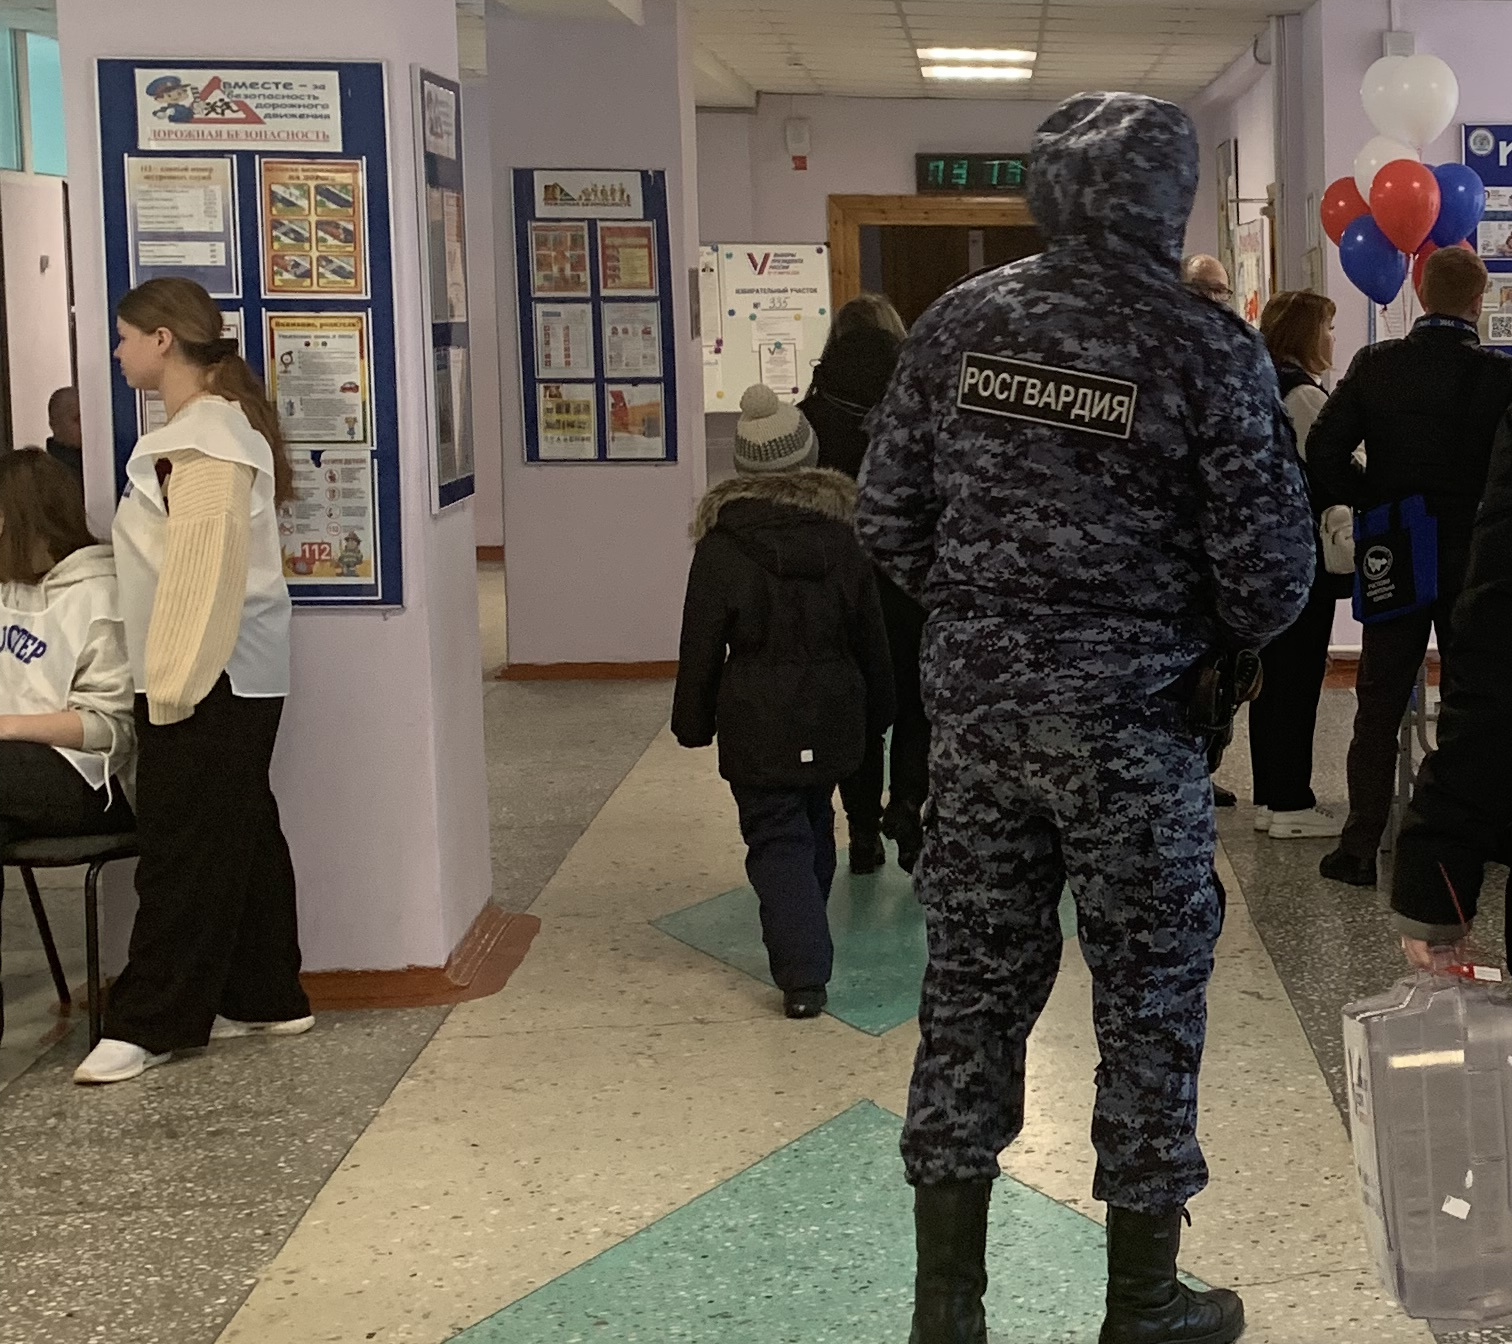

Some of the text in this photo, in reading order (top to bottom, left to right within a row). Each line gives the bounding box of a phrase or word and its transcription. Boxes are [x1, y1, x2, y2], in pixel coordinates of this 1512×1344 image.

[150, 128, 330, 141] ДОРОЖНАЯ БЕЗОПАСНОСТЬ
[735, 287, 789, 295] ИЗБИРАТЕЛЬНЫЙ
[768, 296, 791, 309] 335
[963, 366, 1131, 424] РОСГВАРДИЯ
[301, 543, 331, 560] 112
